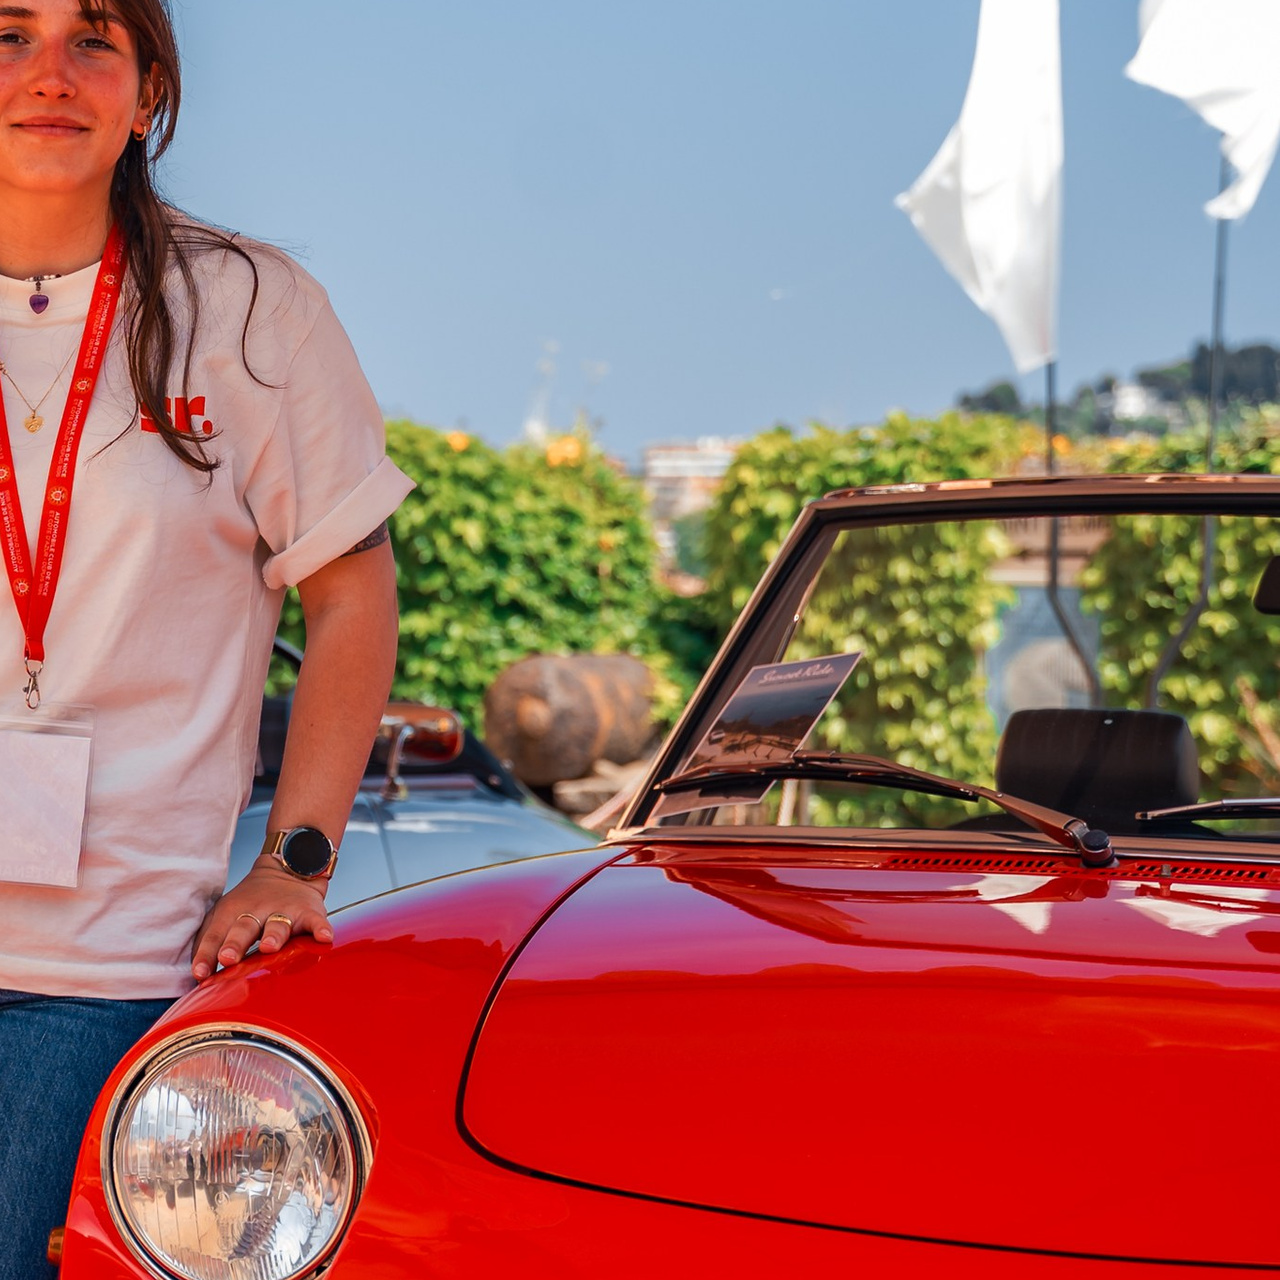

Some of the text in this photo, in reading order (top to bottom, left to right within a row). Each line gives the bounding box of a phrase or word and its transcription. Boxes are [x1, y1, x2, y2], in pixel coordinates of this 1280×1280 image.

[98, 293, 111, 329] AUTOMOBILE
[94, 331, 102, 345] CLUB
[70, 400, 83, 435] AUTOMOBILE
[64, 453, 70, 461] DE
[2, 507, 7, 515] DE
[49, 511, 60, 552] AUTOMOBILE
[7, 533, 18, 572] AUTOMOBILE
[46, 571, 51, 580] DE
